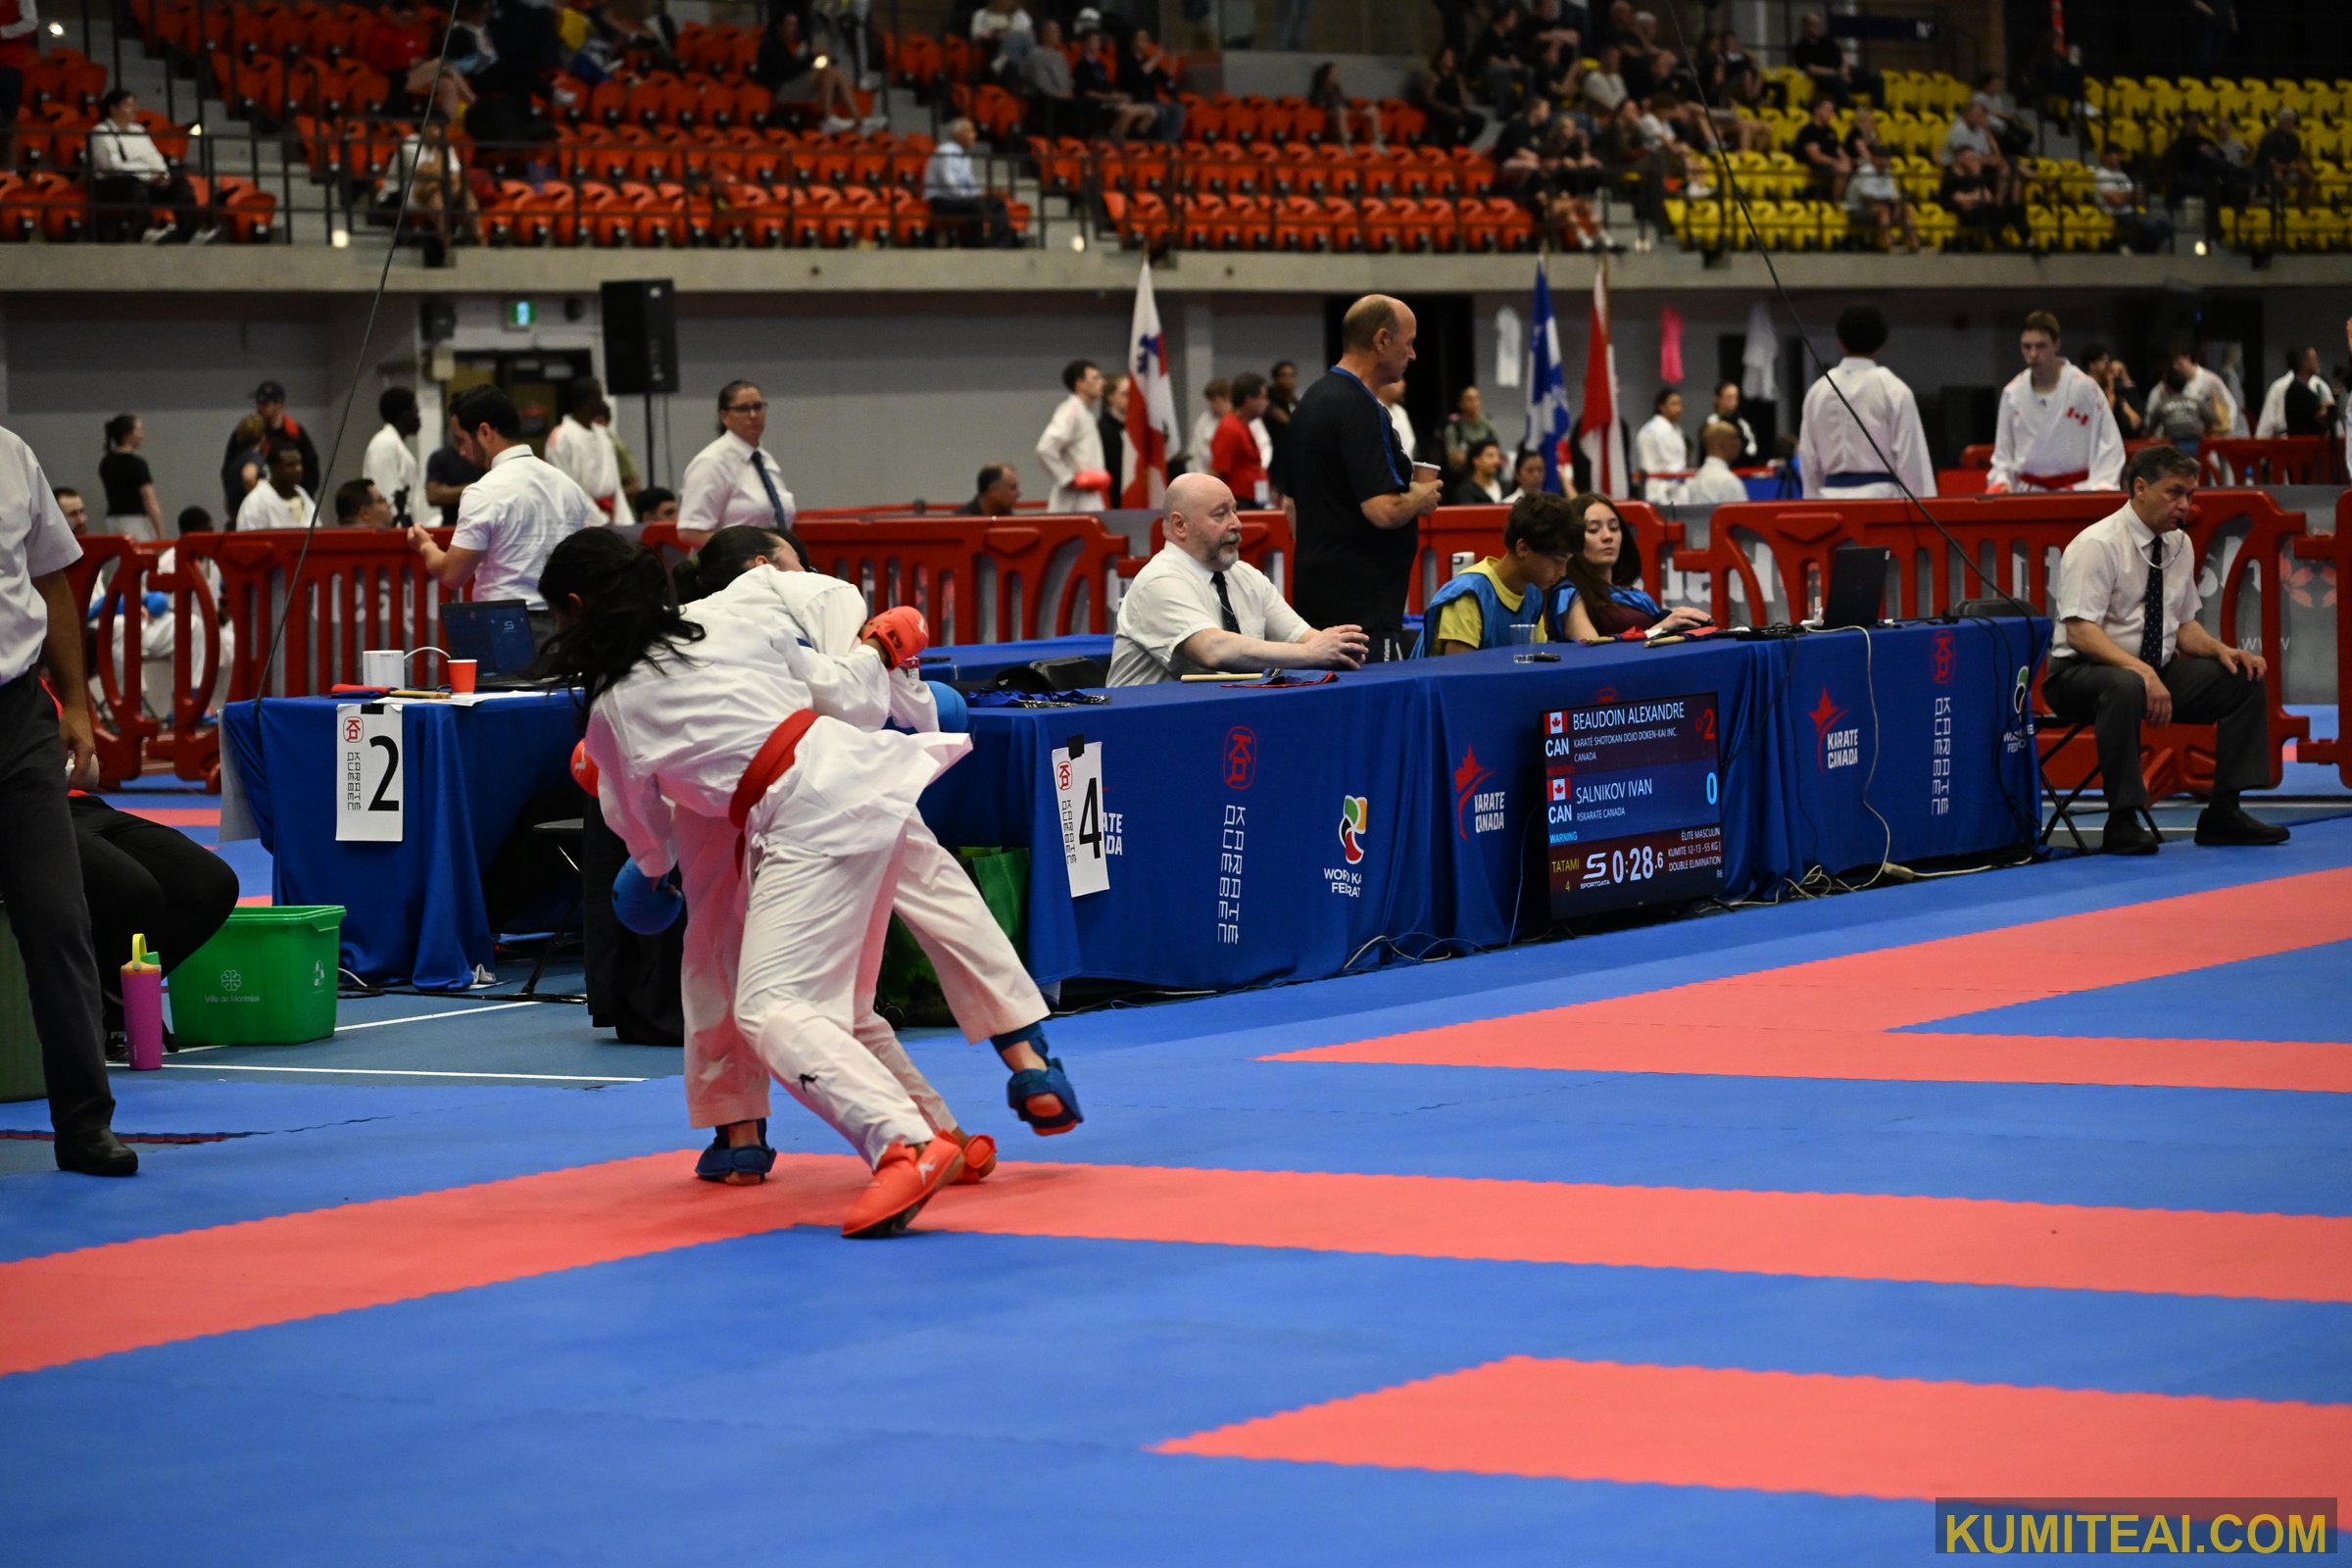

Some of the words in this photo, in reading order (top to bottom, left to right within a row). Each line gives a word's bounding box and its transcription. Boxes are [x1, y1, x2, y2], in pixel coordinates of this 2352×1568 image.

[1573, 709, 1625, 730] BEAUDOIN
[1628, 702, 1685, 724] ALEXANDRE
[1703, 708, 1715, 741] 2
[1594, 734, 1622, 746] SHOTOKAN
[1624, 731, 1638, 742] DOJO
[1639, 729, 1666, 740] DOKEN-KAI
[1828, 729, 1858, 751] KARATE
[1545, 738, 1569, 757] CAN
[1574, 752, 1596, 762] CANADA
[1828, 748, 1858, 769] CANADA
[368, 735, 400, 811] 2
[1576, 782, 1626, 804] SALNIKOV
[1628, 778, 1652, 797] IVAN
[1706, 772, 1718, 805] 0
[1079, 777, 1102, 859] 4
[1548, 804, 1572, 824] CAN
[1603, 807, 1626, 818] CANADA
[1549, 831, 1578, 844] WARNING
[1694, 827, 1721, 839] MASCULIN
[1668, 847, 1687, 858] KUMITE
[1551, 858, 1580, 873] TATAMI
[1668, 860, 1689, 871] DOUBLE
[1690, 856, 1722, 868] ELIMINATION
[1565, 881, 1570, 892] 4
[1580, 879, 1610, 890] SPORTDATA
